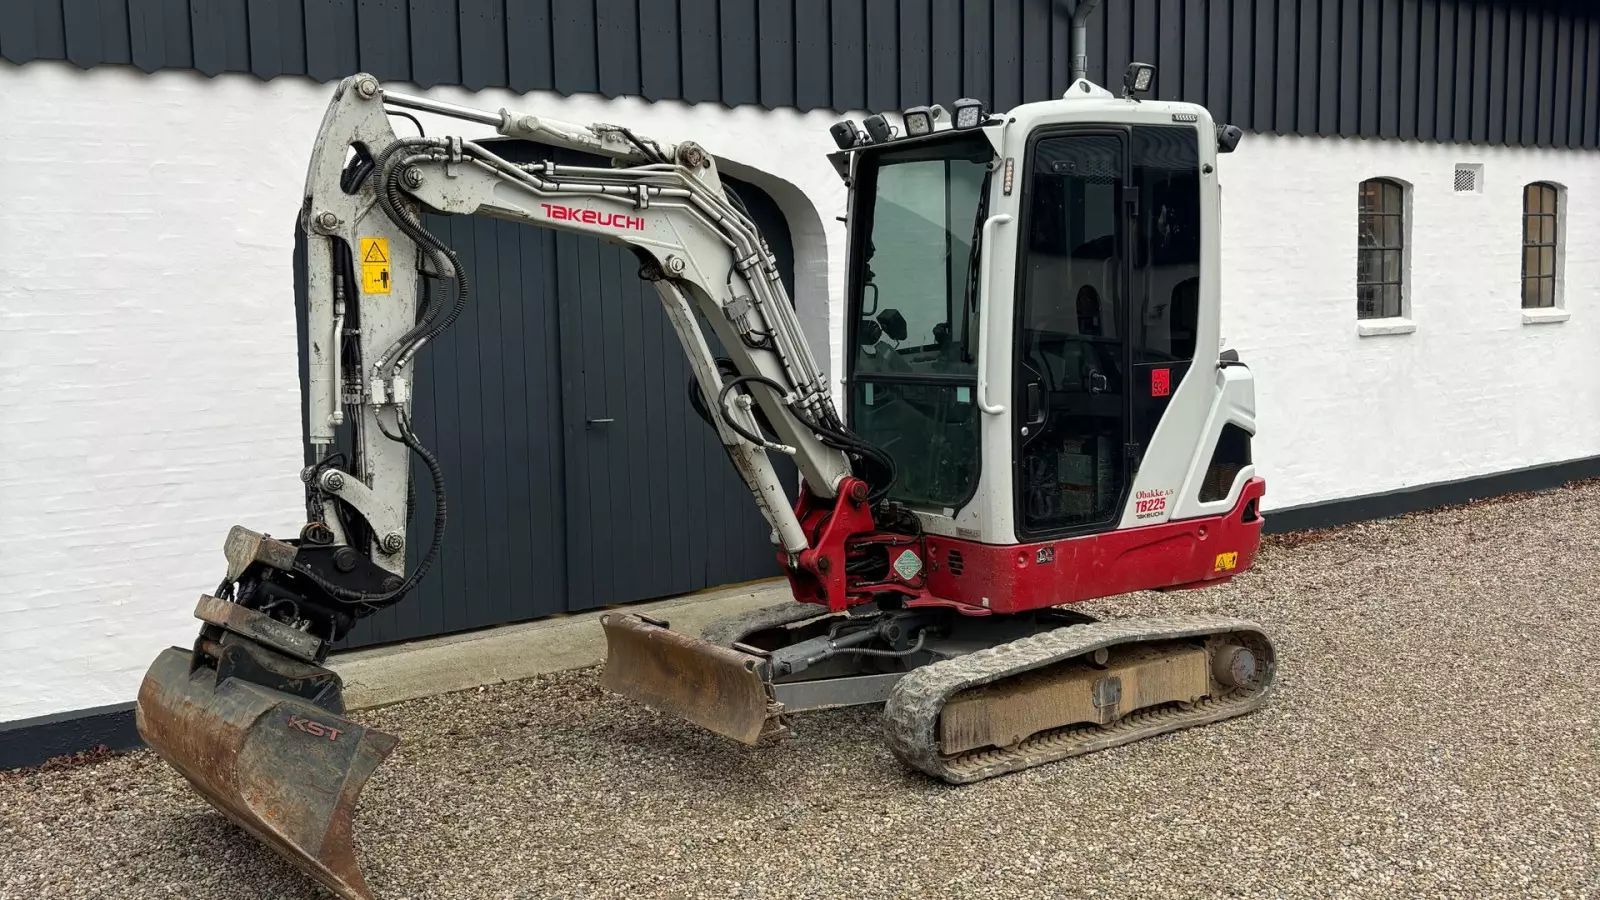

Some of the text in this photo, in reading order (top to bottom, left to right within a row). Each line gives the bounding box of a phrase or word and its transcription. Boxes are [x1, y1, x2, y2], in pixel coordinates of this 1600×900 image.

[540, 203, 645, 231] TAKEUCHI
[1135, 497, 1166, 513] TB225
[288, 714, 344, 742] KST
